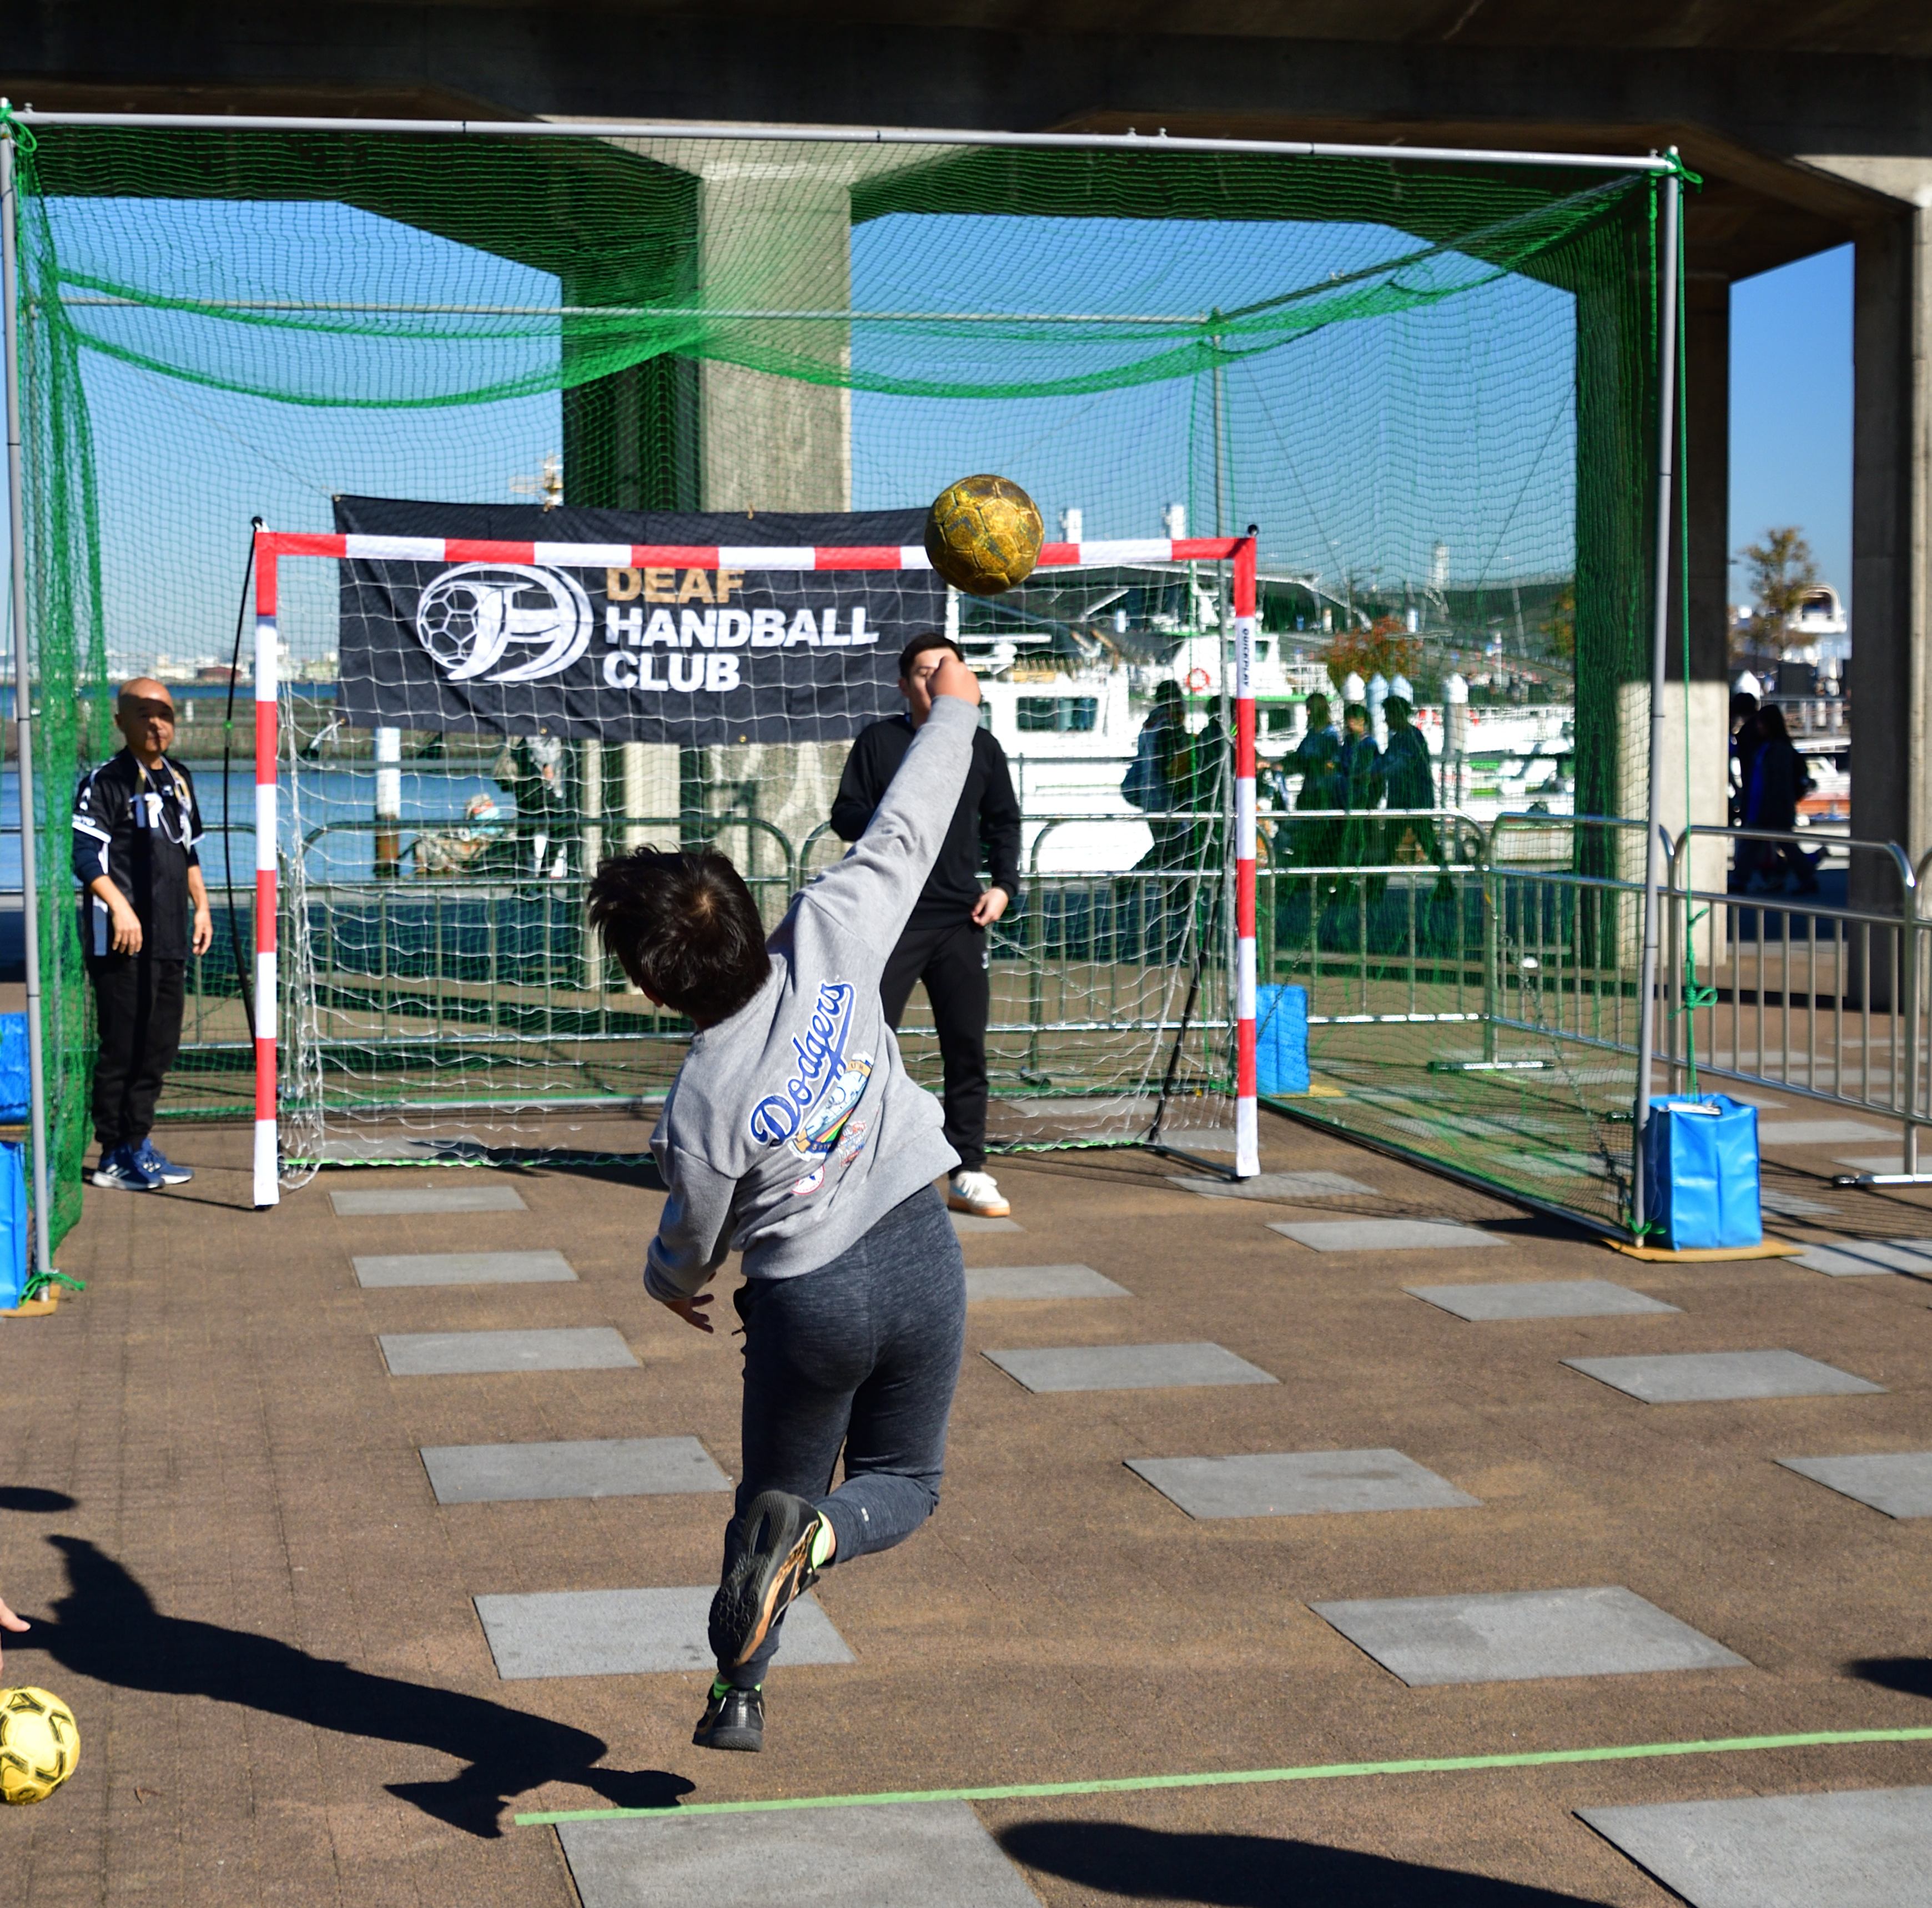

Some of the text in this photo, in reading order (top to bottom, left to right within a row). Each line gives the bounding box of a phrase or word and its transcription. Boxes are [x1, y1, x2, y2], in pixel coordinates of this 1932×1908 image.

[606, 567, 746, 603] DEAF
[605, 606, 879, 648] HANDBALL
[603, 650, 741, 692] CLUB
[750, 981, 855, 1145] Dodgers
